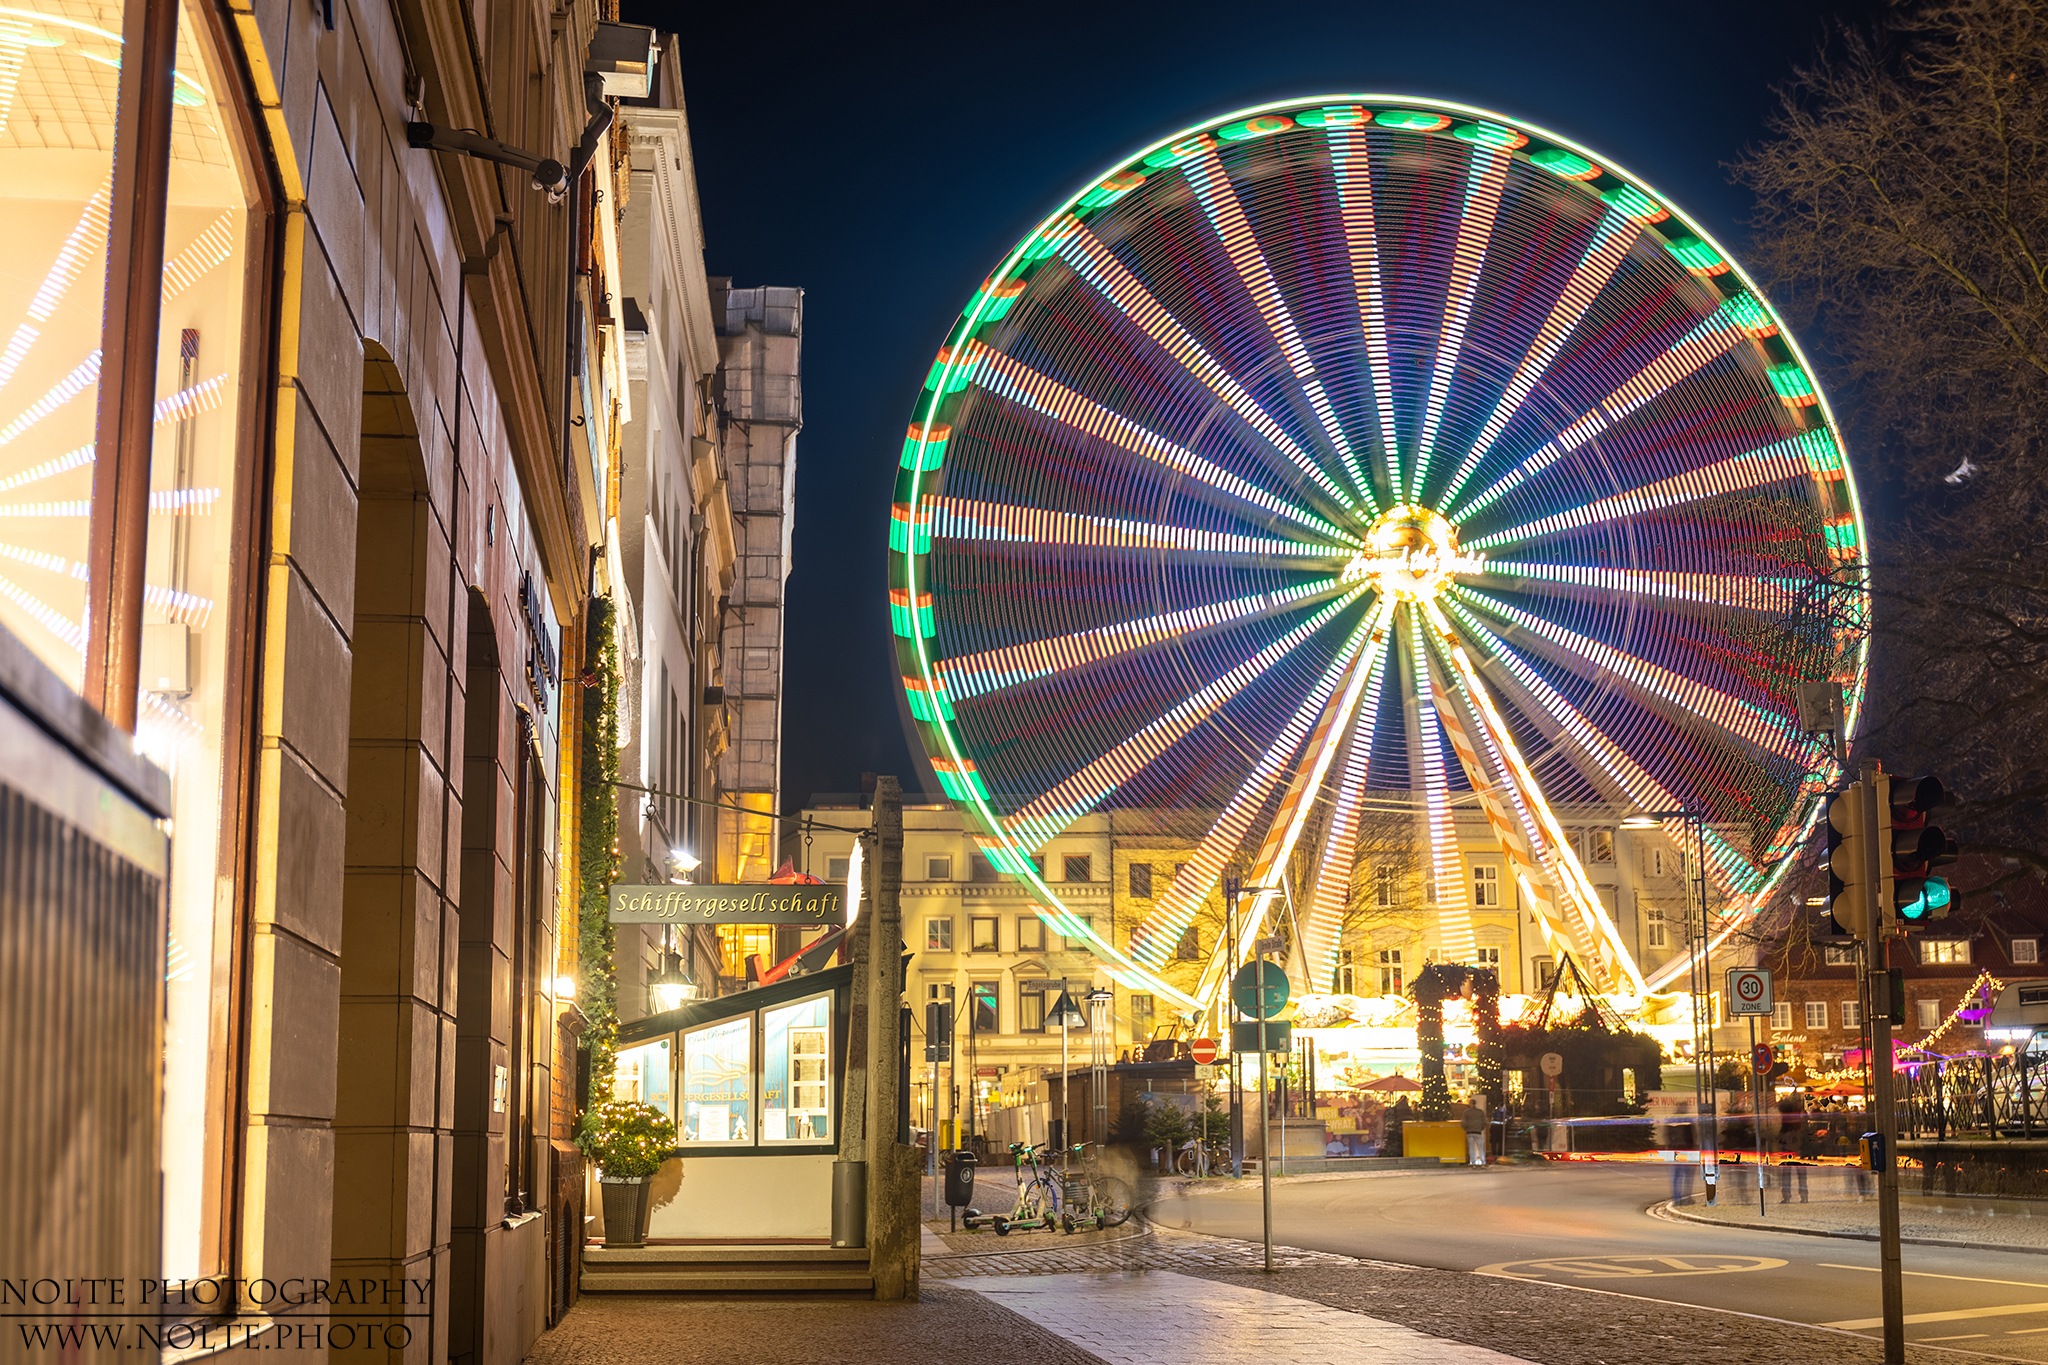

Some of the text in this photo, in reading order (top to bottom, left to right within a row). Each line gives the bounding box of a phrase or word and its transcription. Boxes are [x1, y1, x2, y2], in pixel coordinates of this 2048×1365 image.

[1410, 543, 1437, 571] the
[616, 892, 840, 918] Schiffergesellschaft
[1742, 981, 1759, 995] 30
[1741, 1003, 1762, 1011] ZONE
[1769, 1032, 1808, 1044] Salento
[1316, 1108, 1338, 1120] WISH
